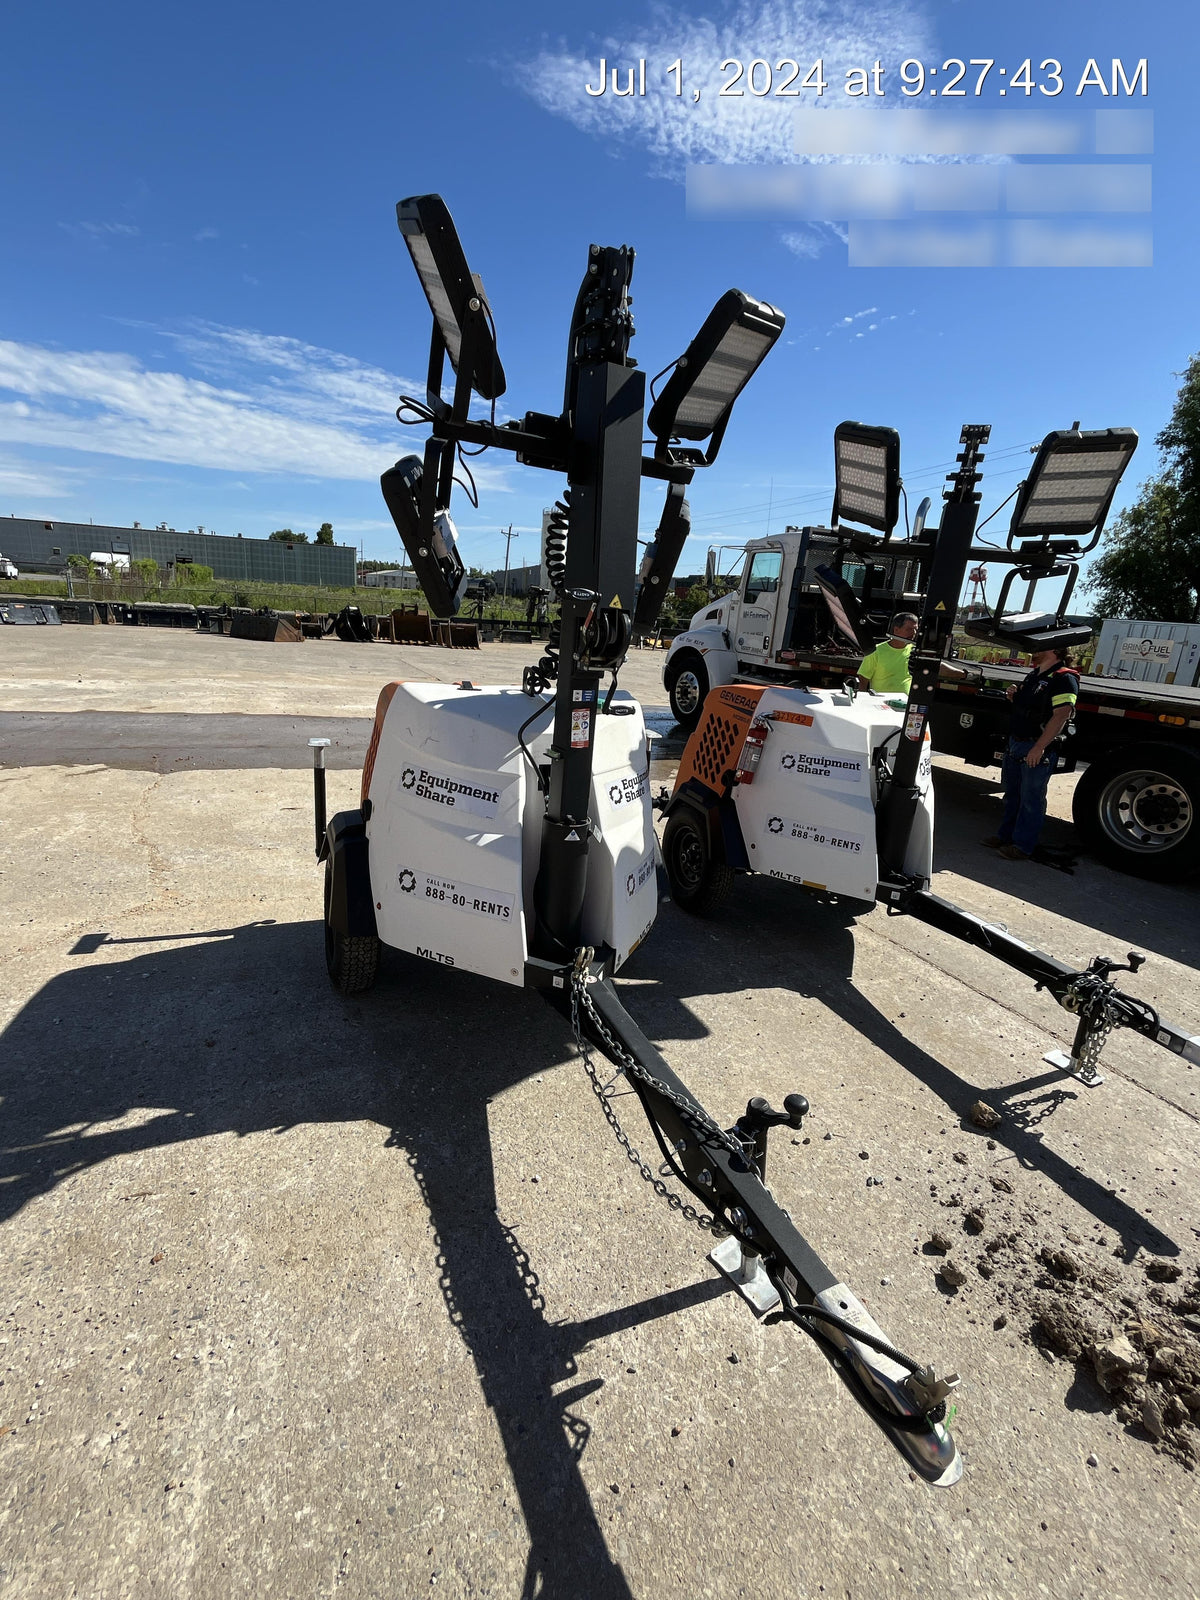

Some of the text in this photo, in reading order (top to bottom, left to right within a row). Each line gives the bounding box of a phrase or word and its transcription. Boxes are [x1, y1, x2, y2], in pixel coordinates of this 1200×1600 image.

[1122, 642, 1171, 654] BRING FUEL
[720, 689, 759, 710] GENERAC
[796, 764, 831, 777] Share
[798, 754, 861, 771] Equipment
[419, 769, 500, 803] Equipment
[624, 786, 646, 803] Share
[415, 784, 456, 807] Share
[792, 822, 805, 830] CALL
[791, 828, 861, 852] 888-80-RENTS
[426, 878, 456, 890] CALL NOW
[769, 869, 802, 883] MLTS
[425, 886, 510, 918] 888-80-RENTS
[416, 946, 455, 966] MLTS
